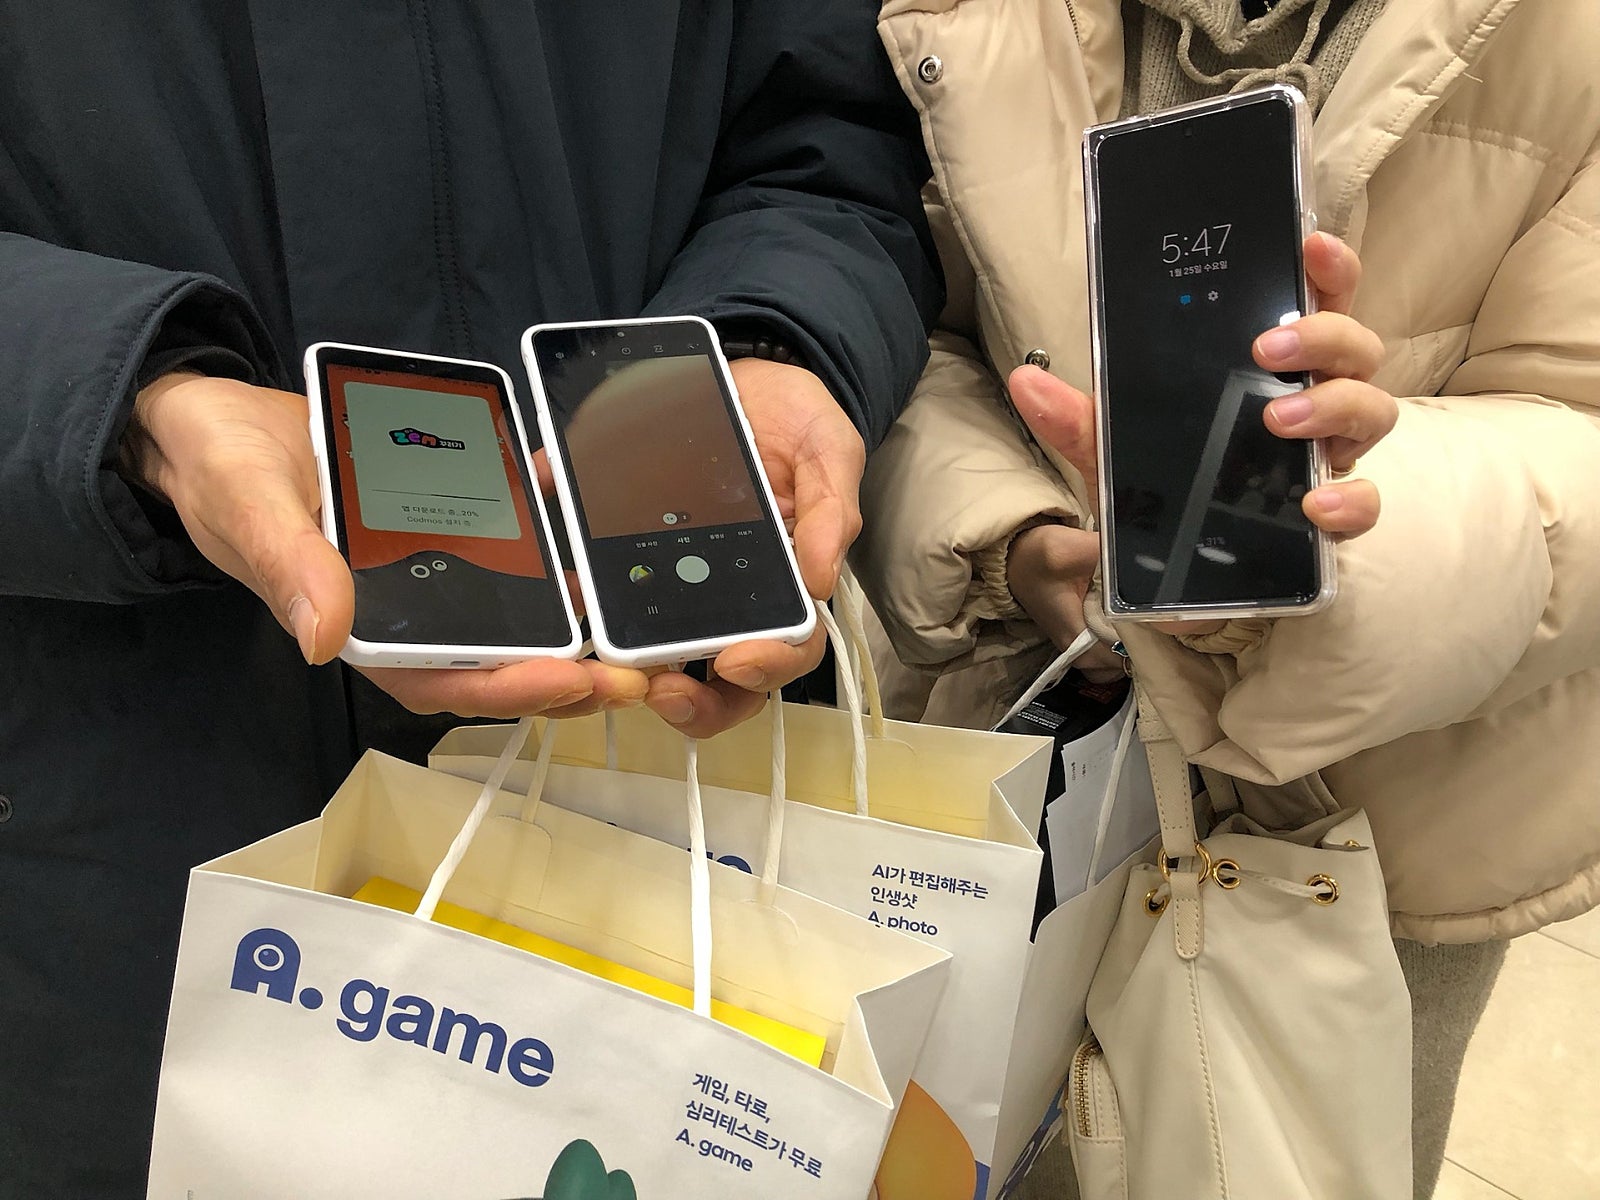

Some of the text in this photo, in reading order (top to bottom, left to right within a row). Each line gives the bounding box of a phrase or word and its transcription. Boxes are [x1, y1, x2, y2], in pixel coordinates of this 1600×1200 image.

[1162, 223, 1232, 263] 5:47
[1169, 260, 1228, 277] 1월 25일 수요일
[412, 506, 446, 515] 다운로드
[870, 886, 919, 910] 인생샷
[871, 864, 989, 900] AI가 편집해주는
[887, 915, 938, 936] photo
[336, 978, 555, 1088] game
[692, 1073, 771, 1124] 게임, 타로,
[675, 1128, 754, 1172] A. game
[685, 1099, 823, 1179] 심리테스트가 무료
